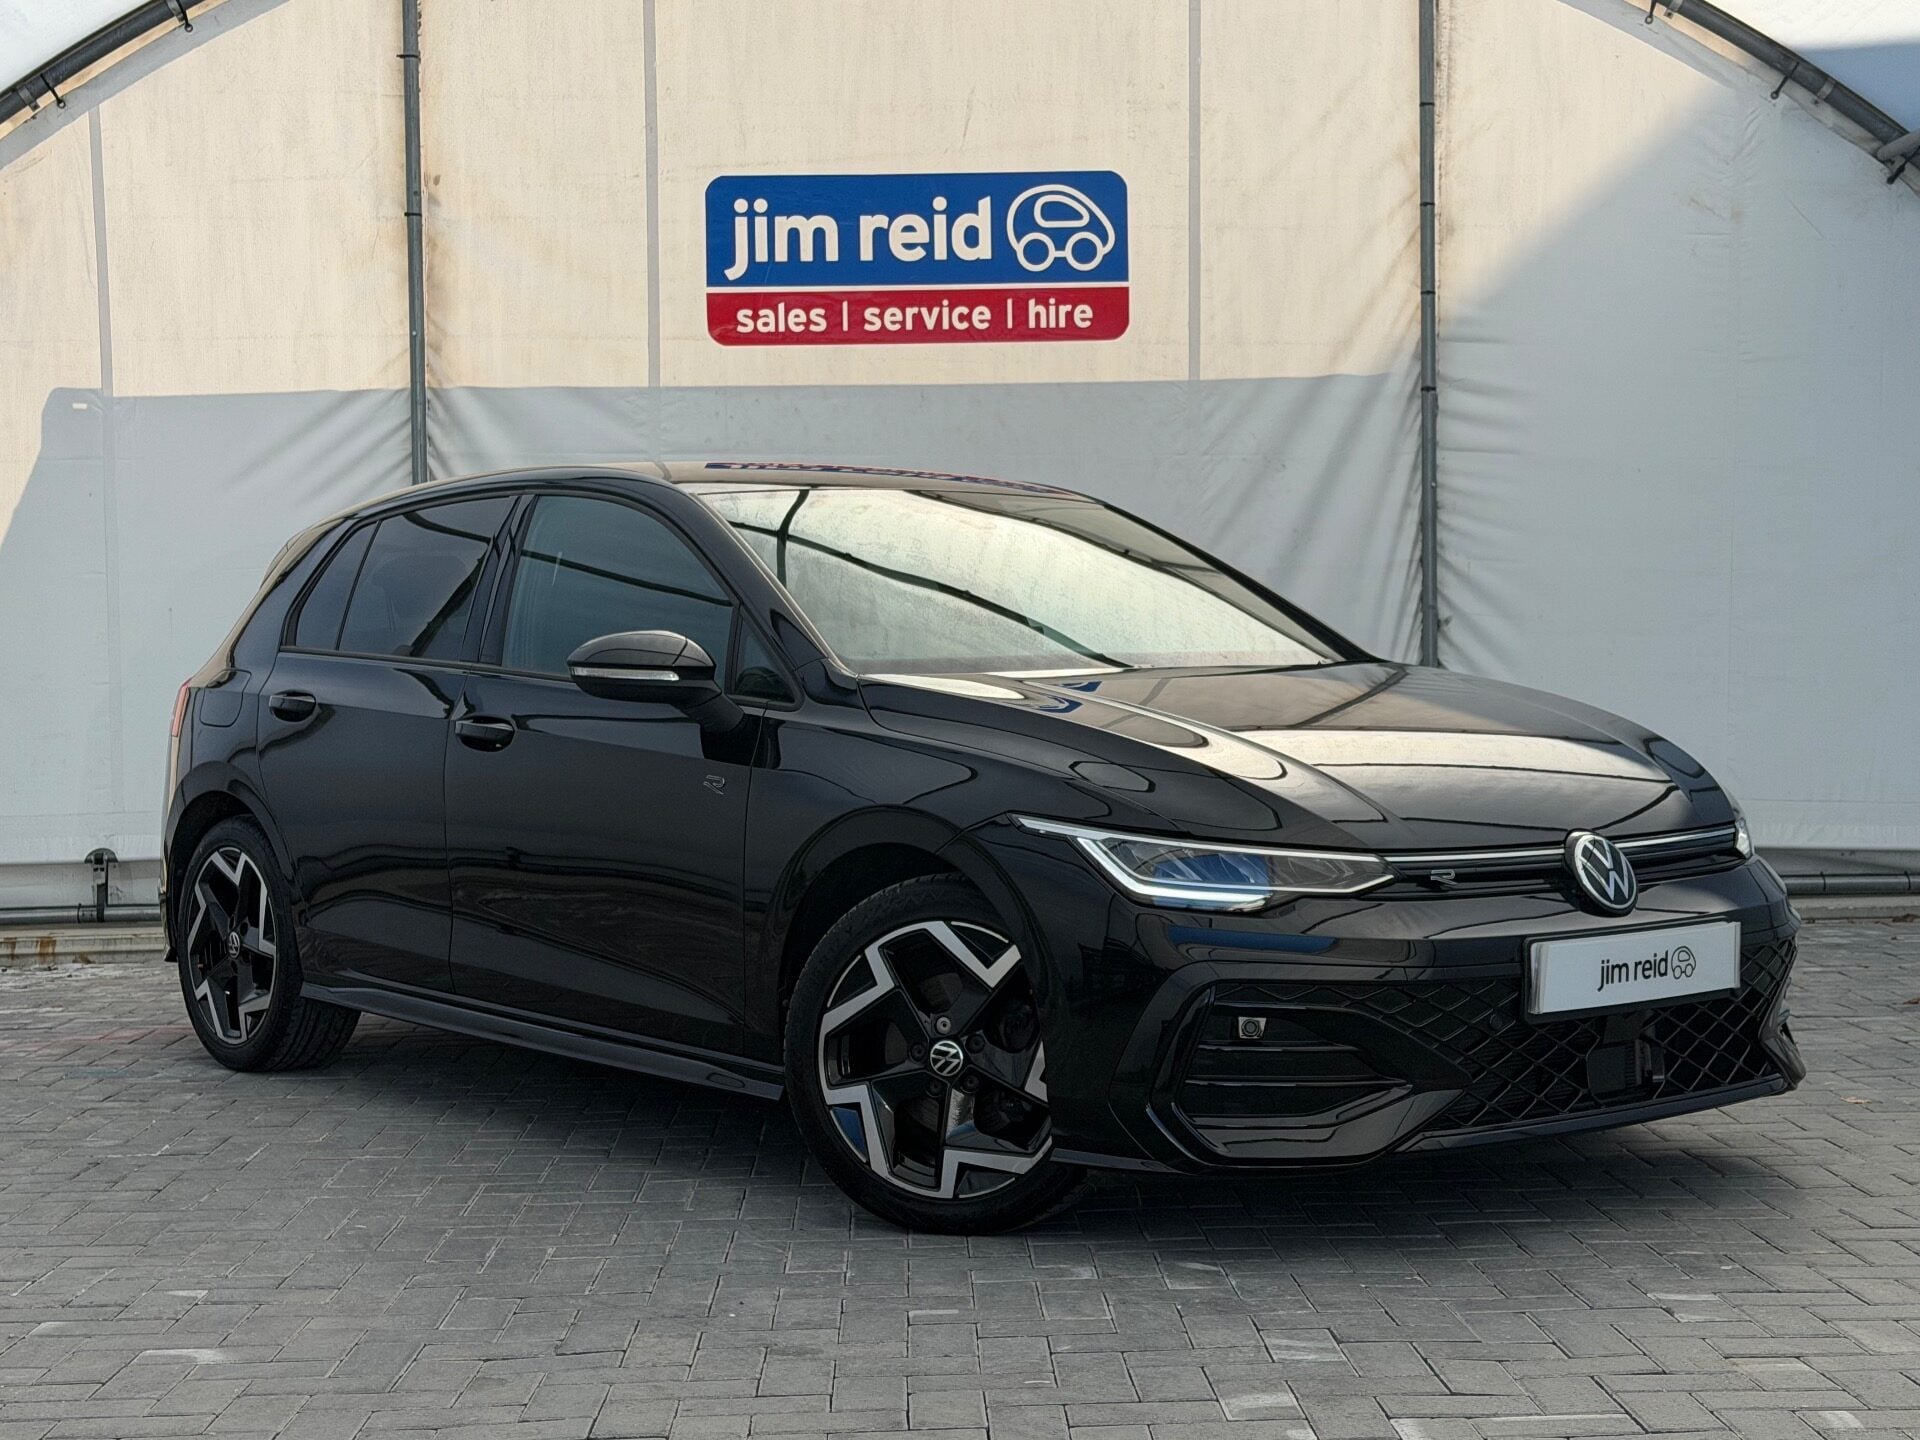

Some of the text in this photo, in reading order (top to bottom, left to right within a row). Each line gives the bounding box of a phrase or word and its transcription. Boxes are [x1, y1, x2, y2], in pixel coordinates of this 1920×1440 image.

[723, 196, 993, 281] jim reid
[736, 297, 1094, 334] sales service hire
[1597, 950, 1669, 992] jim reid
